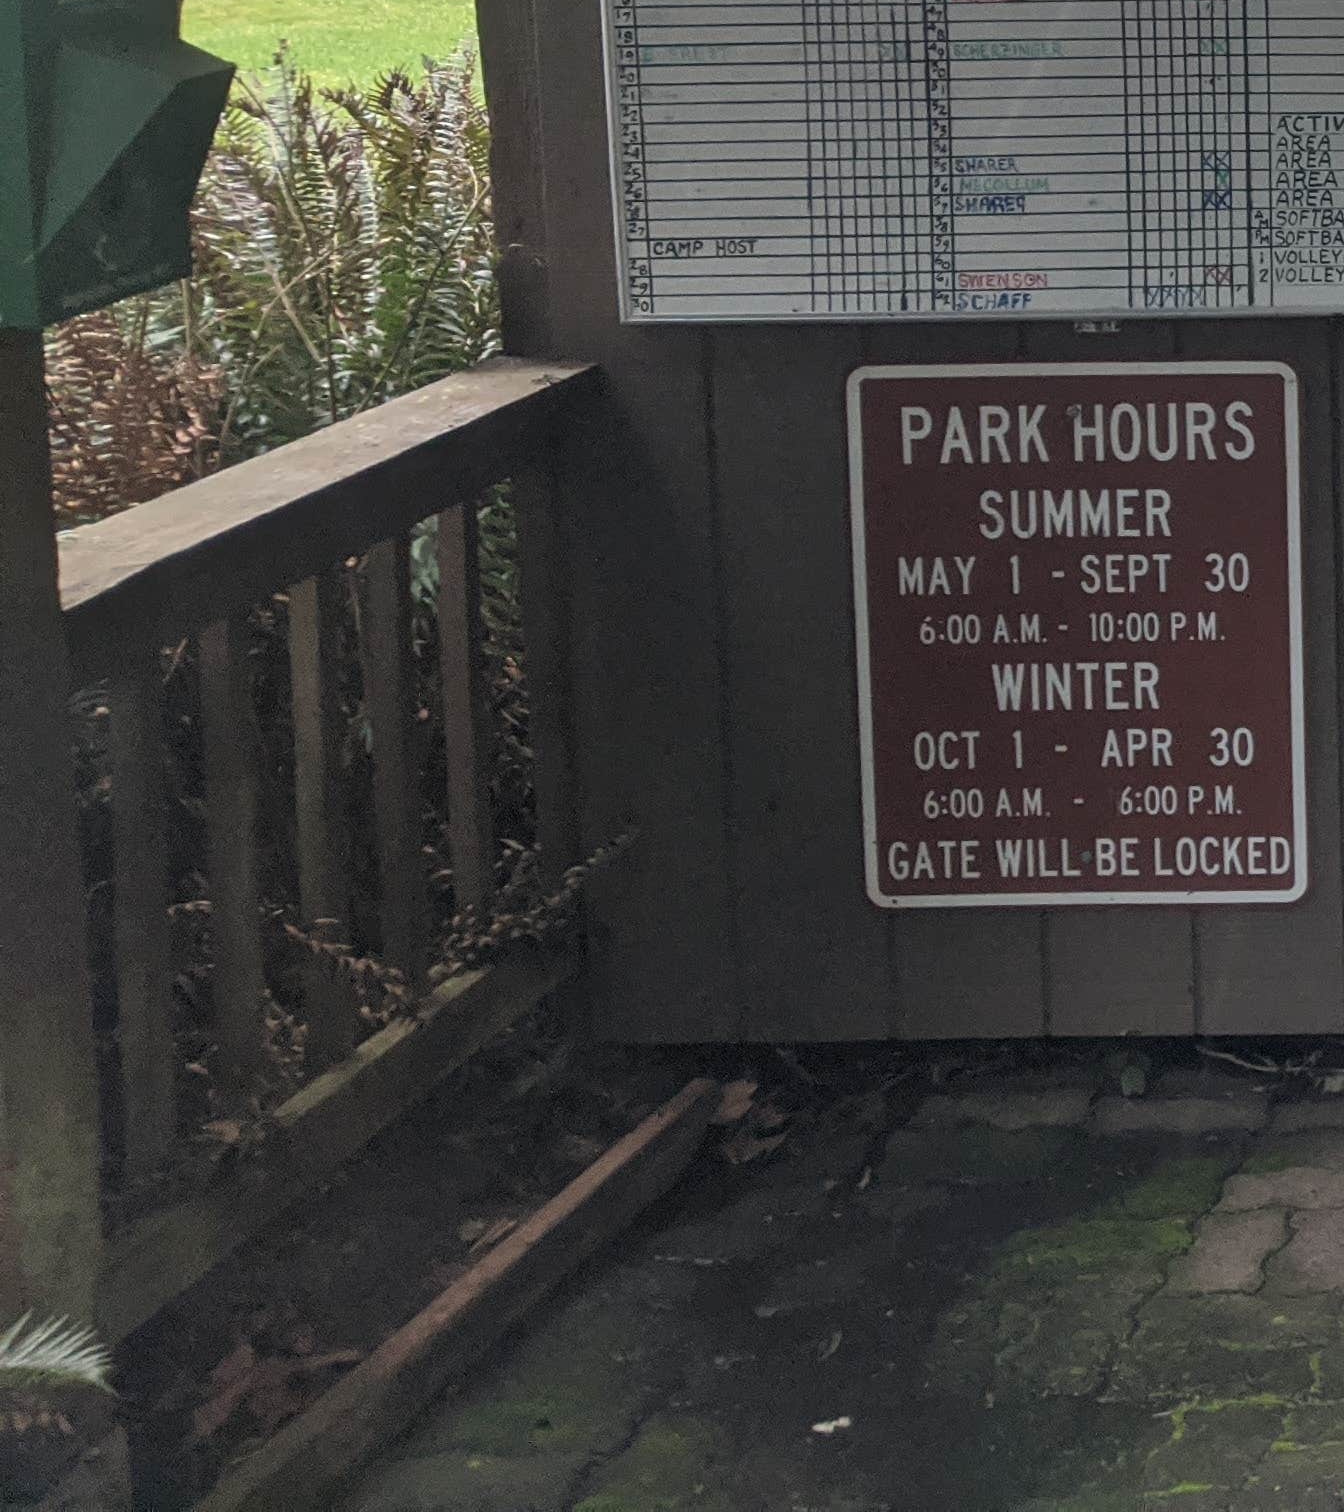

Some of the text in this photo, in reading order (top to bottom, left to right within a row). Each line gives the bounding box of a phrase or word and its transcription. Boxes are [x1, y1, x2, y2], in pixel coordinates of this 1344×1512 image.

[1276, 135, 1331, 151] AREA
[1276, 150, 1332, 169] AREA
[956, 157, 1018, 173] SHARER
[1276, 170, 1338, 188] AREA
[1276, 190, 1333, 207] AREA
[654, 238, 757, 256] CAMP HOST
[956, 291, 1031, 310] SCHAFF
[901, 401, 1255, 464] PARK HOURS
[979, 488, 1172, 540] SUMMER
[898, 556, 976, 596] MAY
[1009, 555, 1020, 595] 1
[1080, 553, 1172, 594] SEPT
[1204, 552, 1250, 593] 30
[919, 614, 981, 645] 6:00
[992, 613, 1048, 644] A.M.
[1089, 611, 1160, 642] 10:00
[1170, 611, 1225, 641] P.M.
[991, 661, 1160, 711] WINTER
[914, 730, 980, 771] OCT
[1012, 730, 1023, 769] 1
[1101, 728, 1173, 768] APR
[1209, 727, 1254, 767] 30
[923, 788, 984, 819] 6:00
[995, 787, 1051, 817] A.M.
[1119, 785, 1178, 816] 6:00
[1188, 785, 1242, 815] P.M.
[888, 836, 1291, 880] GATE WILL BE LOCKED
